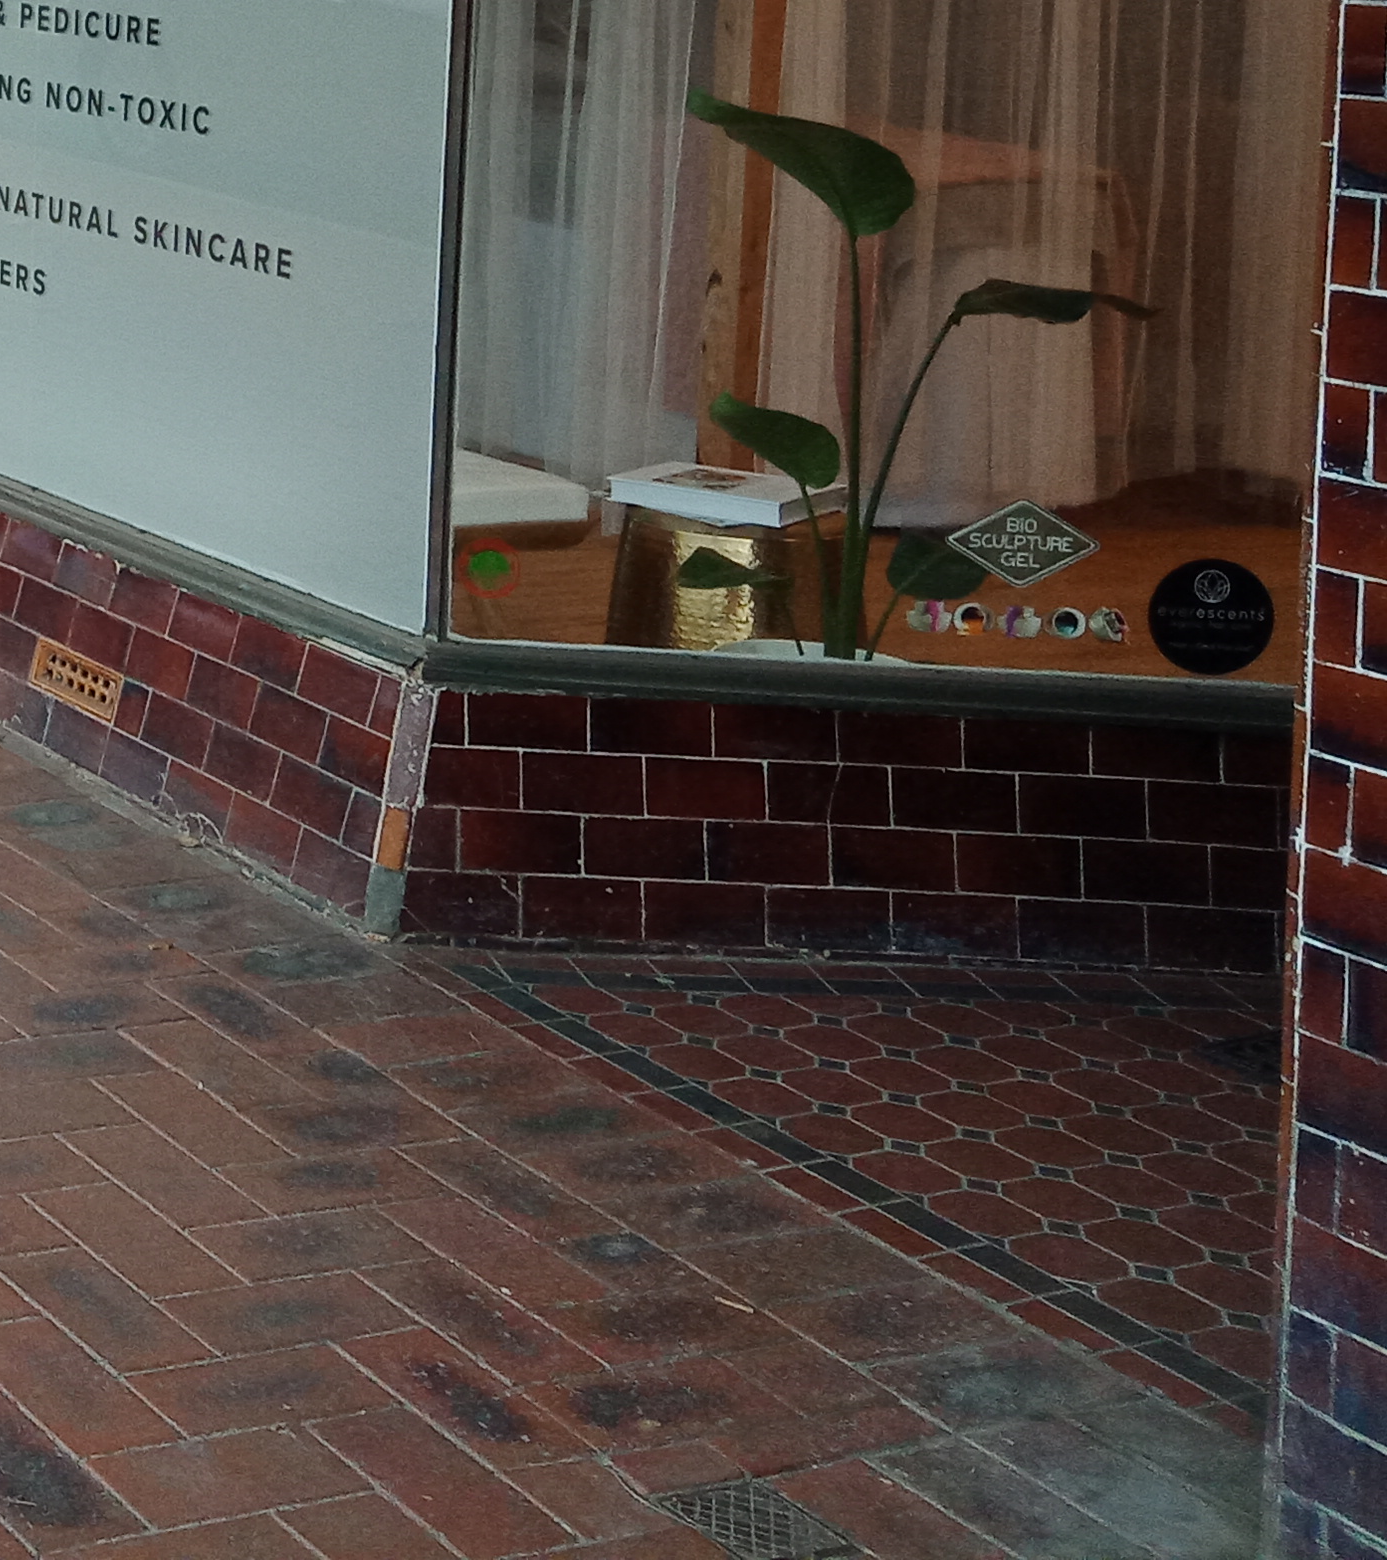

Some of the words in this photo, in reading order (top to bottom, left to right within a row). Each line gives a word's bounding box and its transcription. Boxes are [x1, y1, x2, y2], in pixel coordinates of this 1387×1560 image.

[20, 2, 162, 46] PEDICURE
[46, 81, 211, 136] NON-TOXIC
[134, 216, 293, 280] SKINCARE
[1006, 517, 1038, 534] BIO
[968, 532, 1074, 553] SCULPTURE
[1000, 551, 1041, 569] GEL
